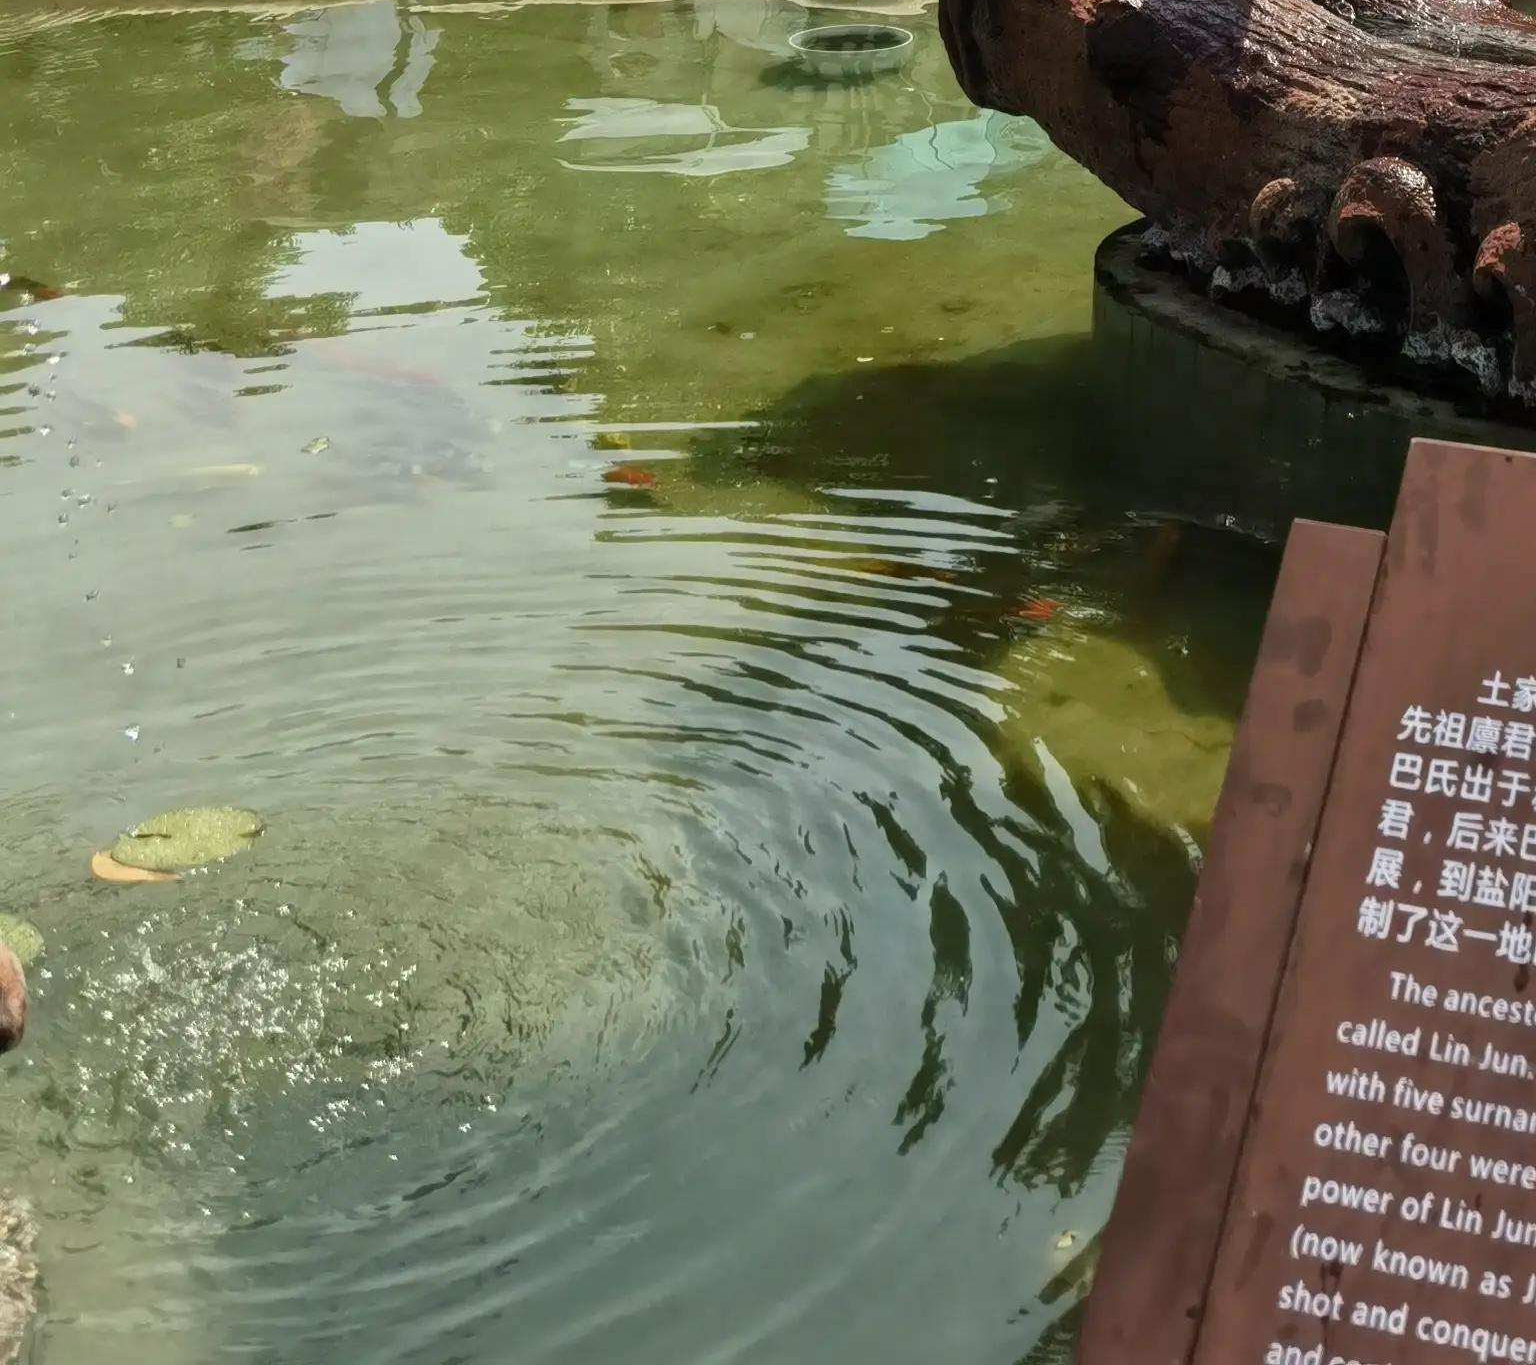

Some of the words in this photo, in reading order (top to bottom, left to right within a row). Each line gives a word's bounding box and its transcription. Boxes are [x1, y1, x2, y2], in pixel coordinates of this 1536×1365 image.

[1390, 971, 1439, 1008] The
[1336, 1018, 1422, 1057] called
[1429, 1031, 1471, 1066] Lin
[1478, 1042, 1534, 1080] Jun.
[1326, 1067, 1386, 1103] with
[1392, 1076, 1445, 1116] five
[1313, 1120, 1393, 1158] other
[1400, 1132, 1462, 1173] four
[1299, 1175, 1394, 1215] power
[1399, 1192, 1435, 1224] of
[1438, 1197, 1483, 1235] Lin
[1290, 1224, 1364, 1266] (now
[1371, 1239, 1469, 1290] known
[1478, 1271, 1513, 1299] as
[1278, 1280, 1345, 1321] shot
[1350, 1301, 1409, 1335] and
